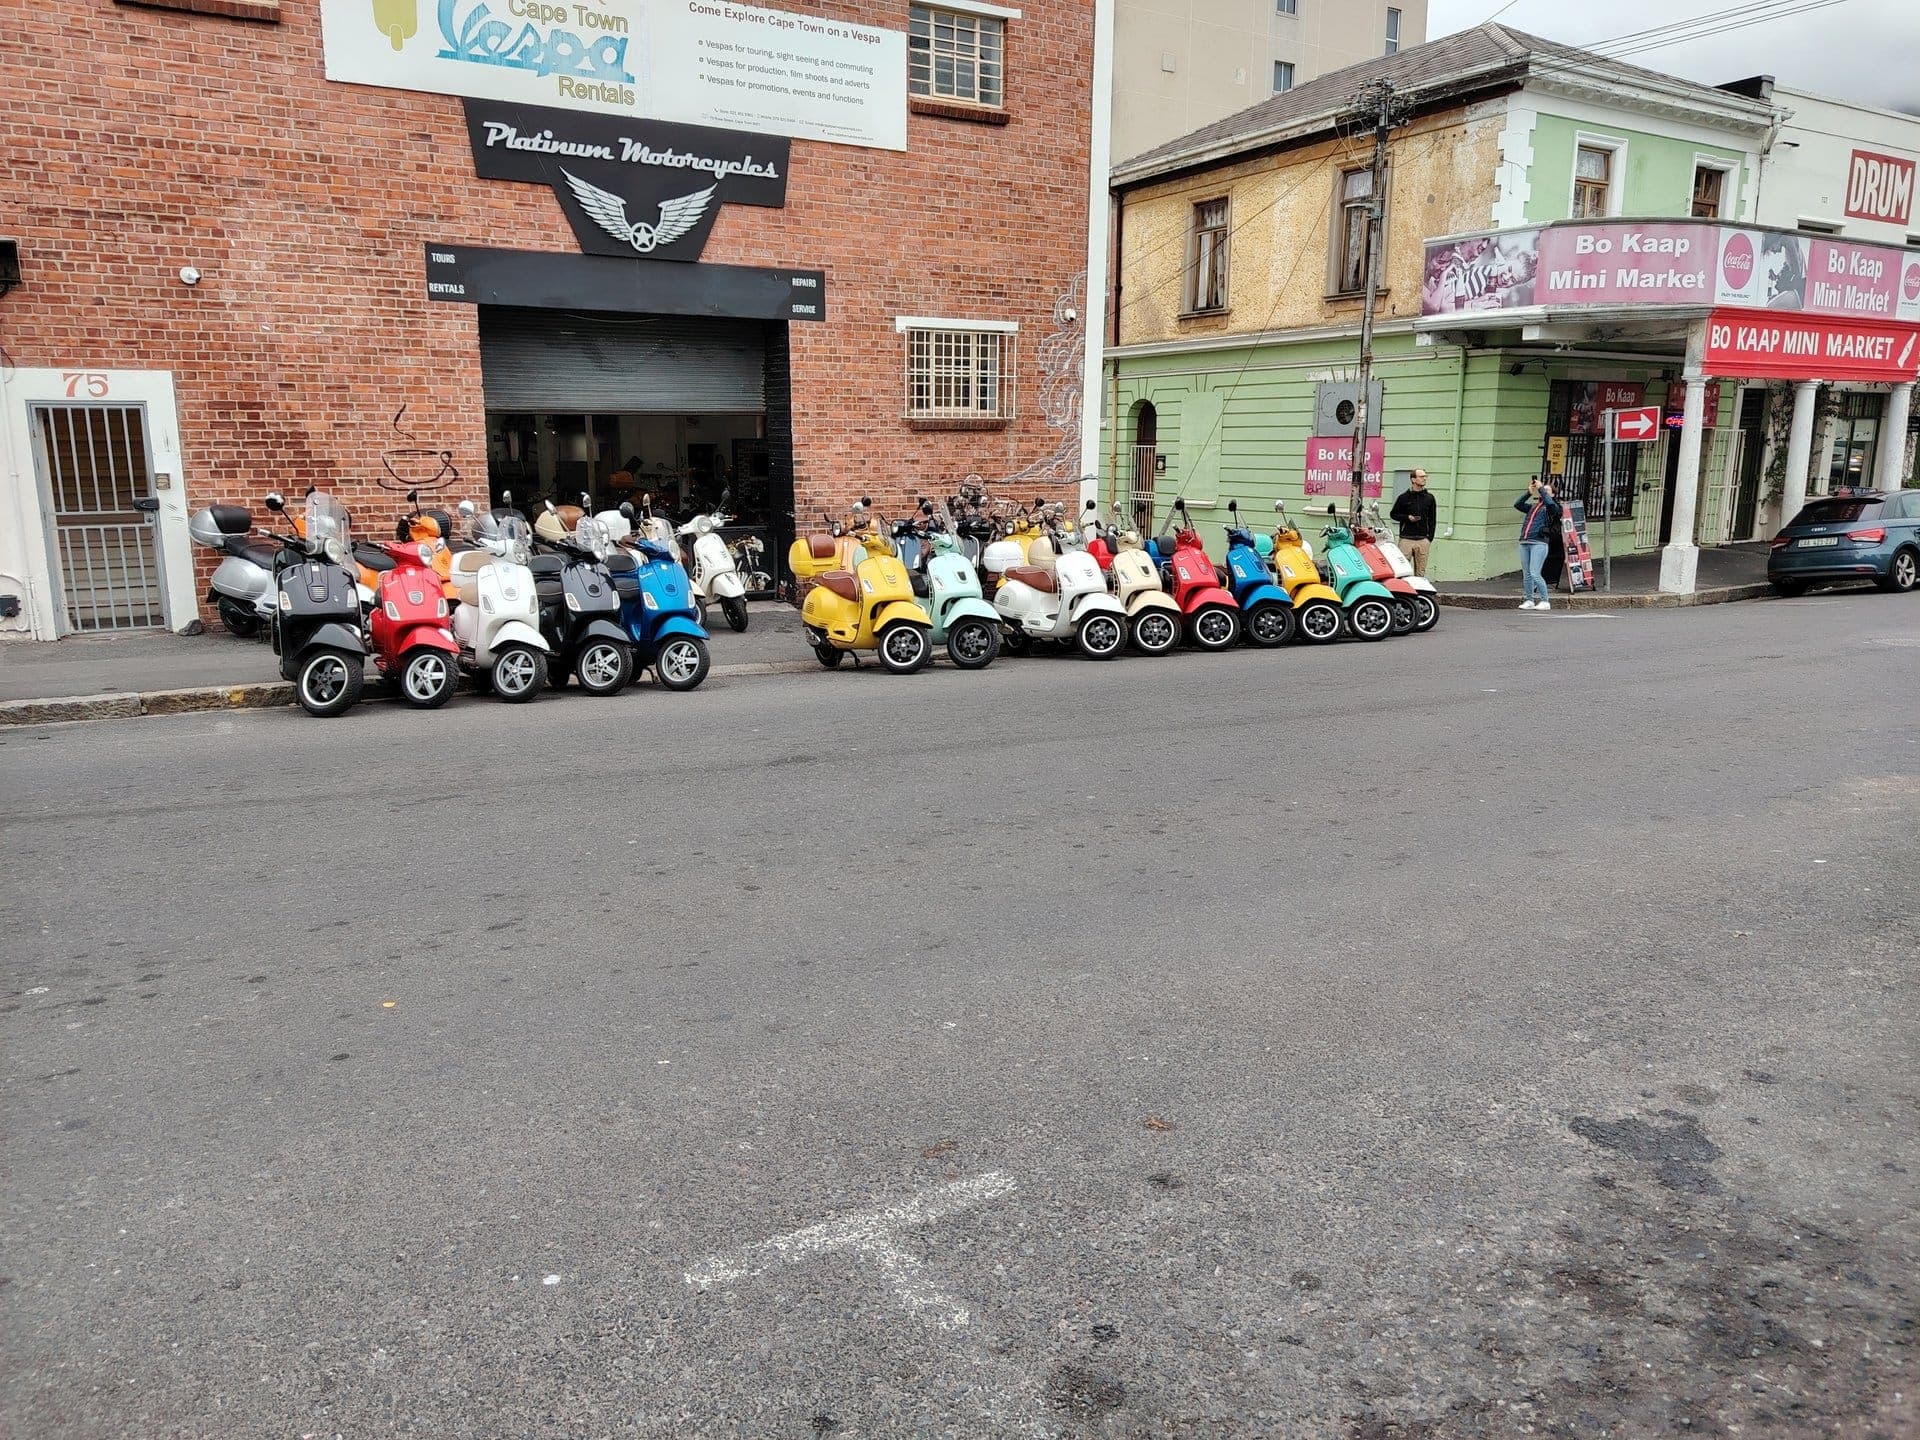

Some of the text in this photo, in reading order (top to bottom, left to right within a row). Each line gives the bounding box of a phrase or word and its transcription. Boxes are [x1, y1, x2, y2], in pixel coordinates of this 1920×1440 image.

[508, 0, 629, 34] Cape Town
[689, 1, 881, 44] Come Explore Cape Town on a Vespa
[435, 0, 635, 83] Vespa
[705, 39, 874, 76] Vespas for touring, sight seeing and commuting
[706, 57, 734, 69] Vespas
[735, 61, 746, 70] for
[790, 69, 804, 79] film
[804, 73, 829, 83] shoots
[829, 76, 843, 86] and
[844, 79, 870, 89] adverts
[558, 75, 636, 106] Rentals
[706, 74, 735, 87] Vespas
[736, 78, 746, 88] for
[792, 88, 816, 98] events
[817, 92, 831, 101] and
[832, 93, 864, 106] functions
[483, 120, 779, 179] Platinum Motorcycles
[1848, 156, 1913, 220] DRUM
[431, 252, 456, 264] TOURS
[1576, 233, 1690, 257] Bo Kaap
[1549, 268, 1706, 291] Mini Market
[1828, 248, 1883, 284] Bo Kaap
[428, 282, 465, 294] RENTALS
[791, 277, 817, 289] REPAIRS
[1813, 281, 1890, 313] Mini Market
[791, 303, 816, 316] SERVICE
[1710, 324, 1895, 361] BO KAAP MINI MARKET
[62, 373, 109, 397] 75
[1605, 387, 1636, 405] Bo Kaap
[1318, 448, 1371, 461] Bo Kap
[1307, 469, 1381, 483] Mini Maket
